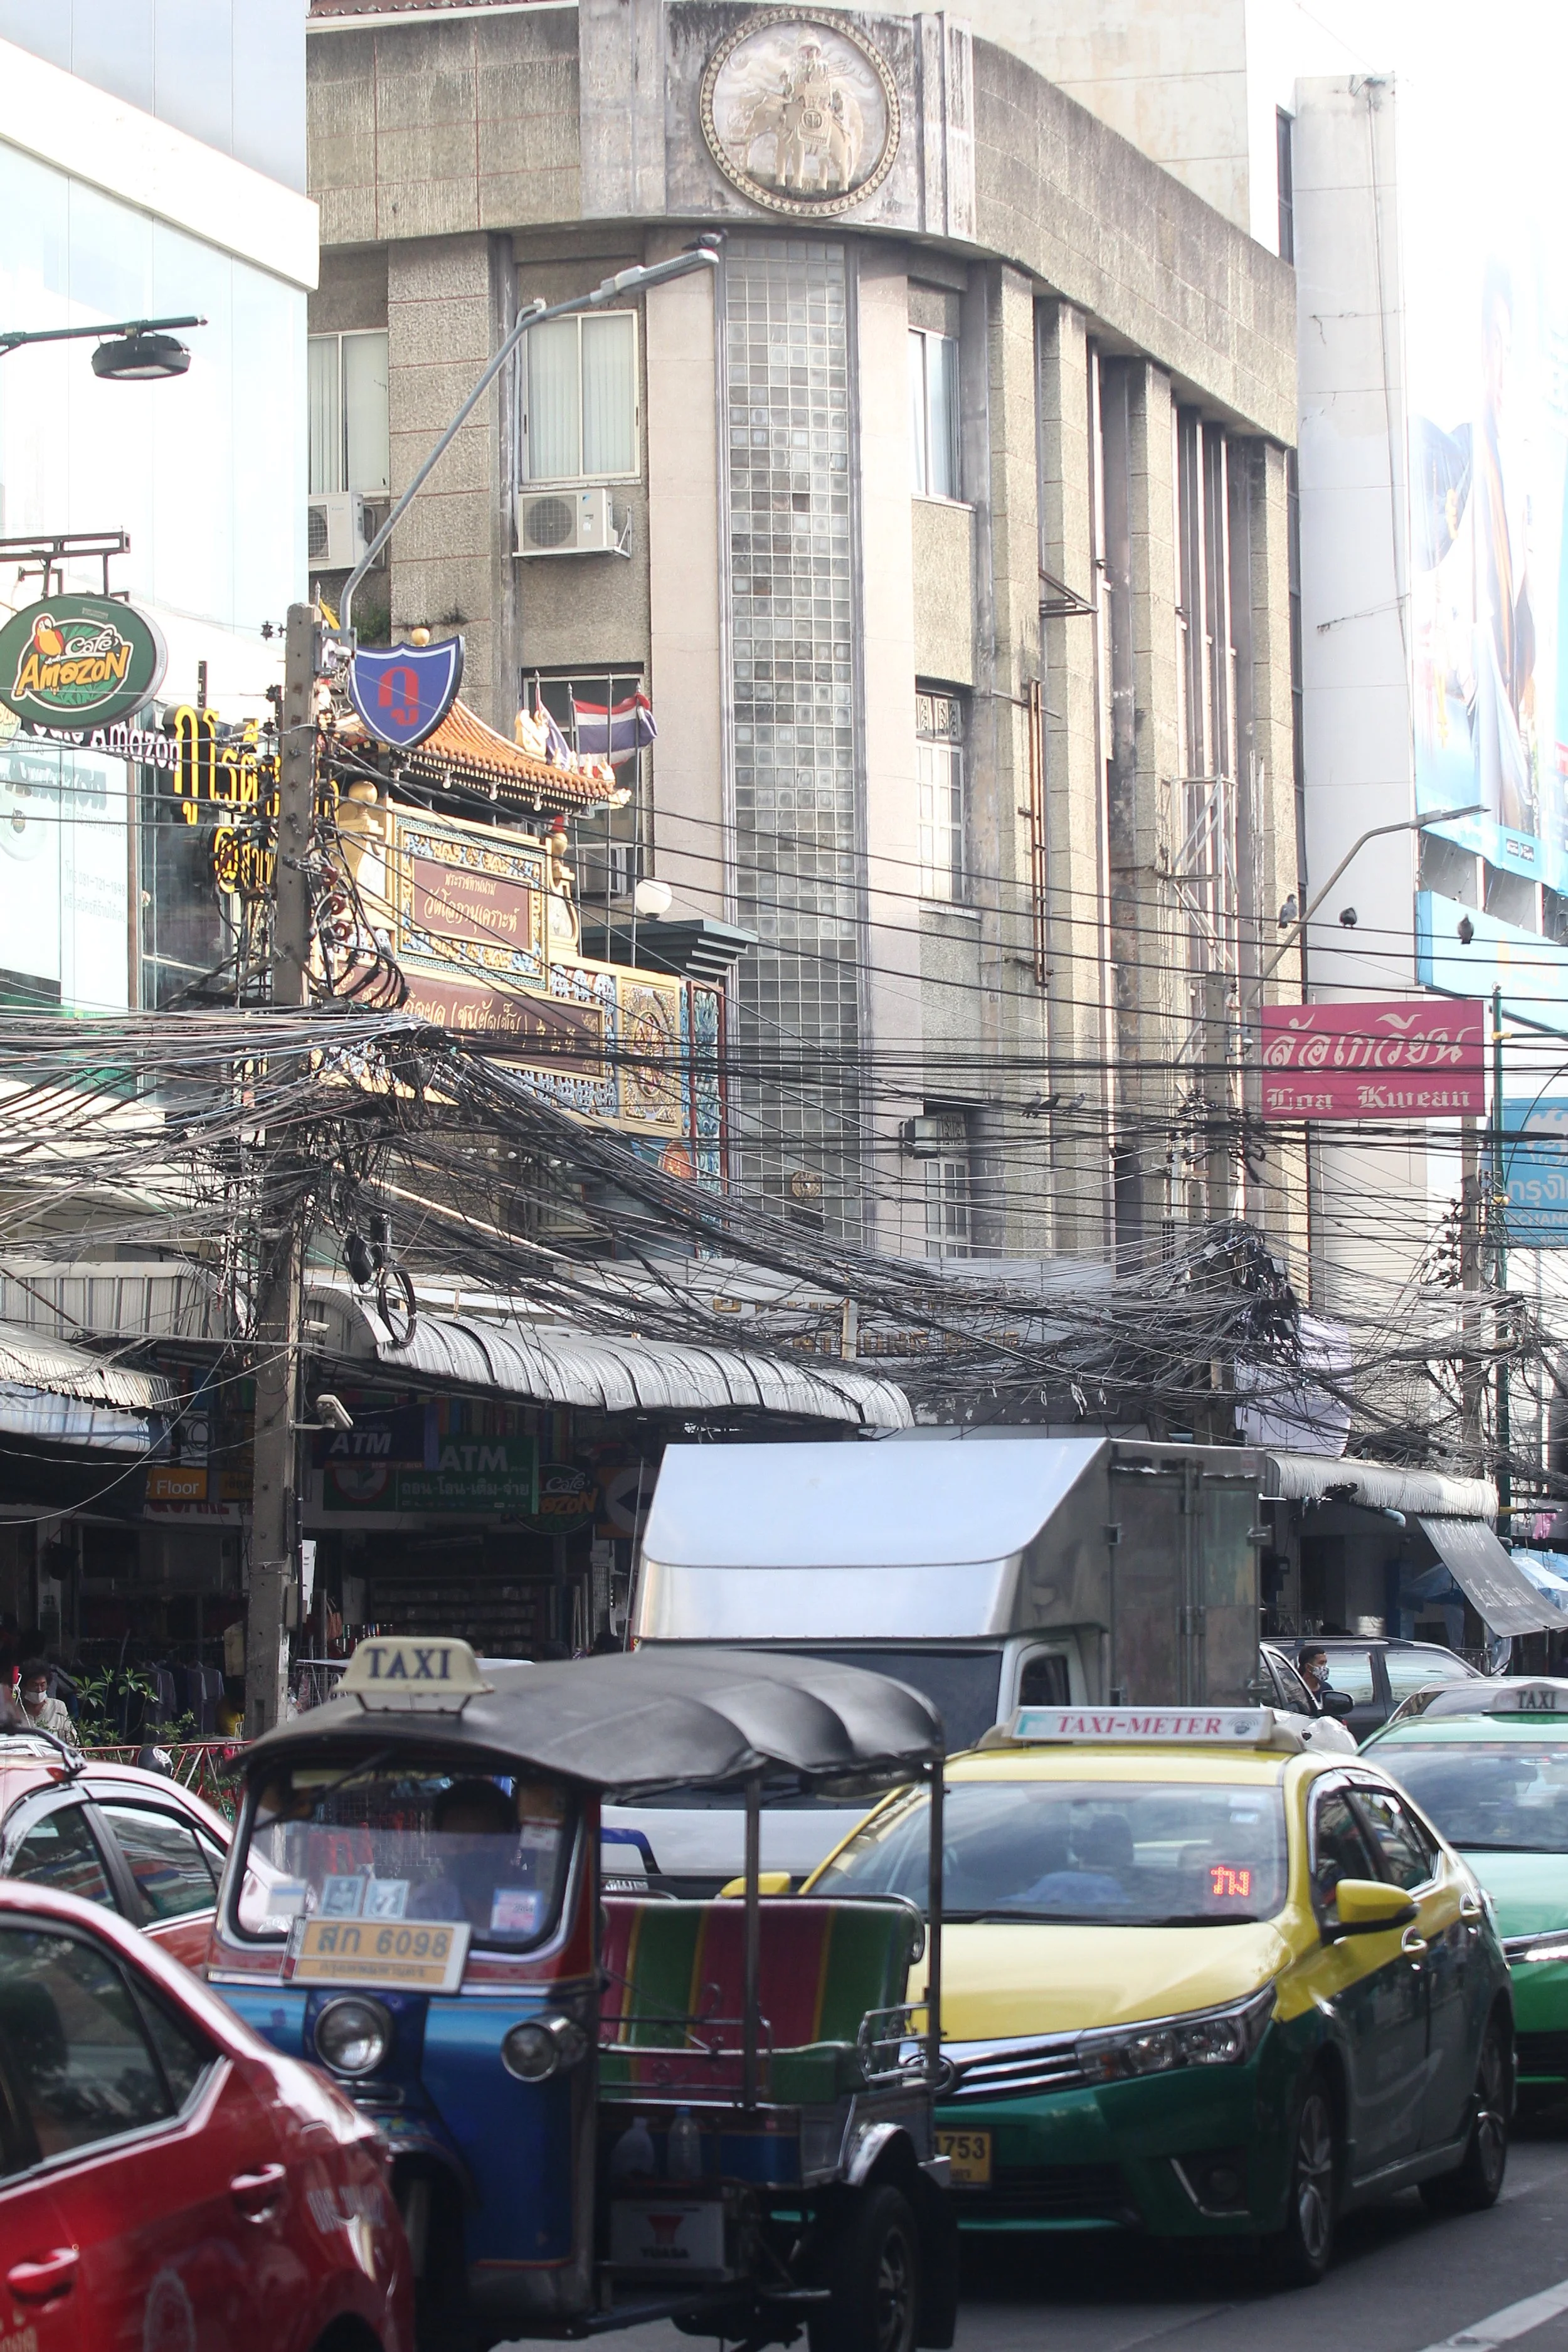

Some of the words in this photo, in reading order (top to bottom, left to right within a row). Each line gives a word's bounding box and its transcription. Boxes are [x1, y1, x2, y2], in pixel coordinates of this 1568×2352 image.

[378, 666, 419, 726] กู
[445, 872, 497, 896] พระราชทานนาม
[424, 887, 521, 935] วัดโลกานุเคราะห์
[1263, 1013, 1481, 1074] ล้อเกวียน
[1357, 1086, 1471, 1108] Kwean
[329, 1433, 392, 1454] ATM
[439, 1445, 509, 1472] ATM
[157, 1480, 199, 1495] Floor
[364, 1648, 452, 1681] TAXI
[1515, 1689, 1557, 1710] TAXI
[1056, 1715, 1222, 1735] TAXI-METER
[318, 1925, 362, 1953] สก
[375, 1928, 448, 1958] 6098
